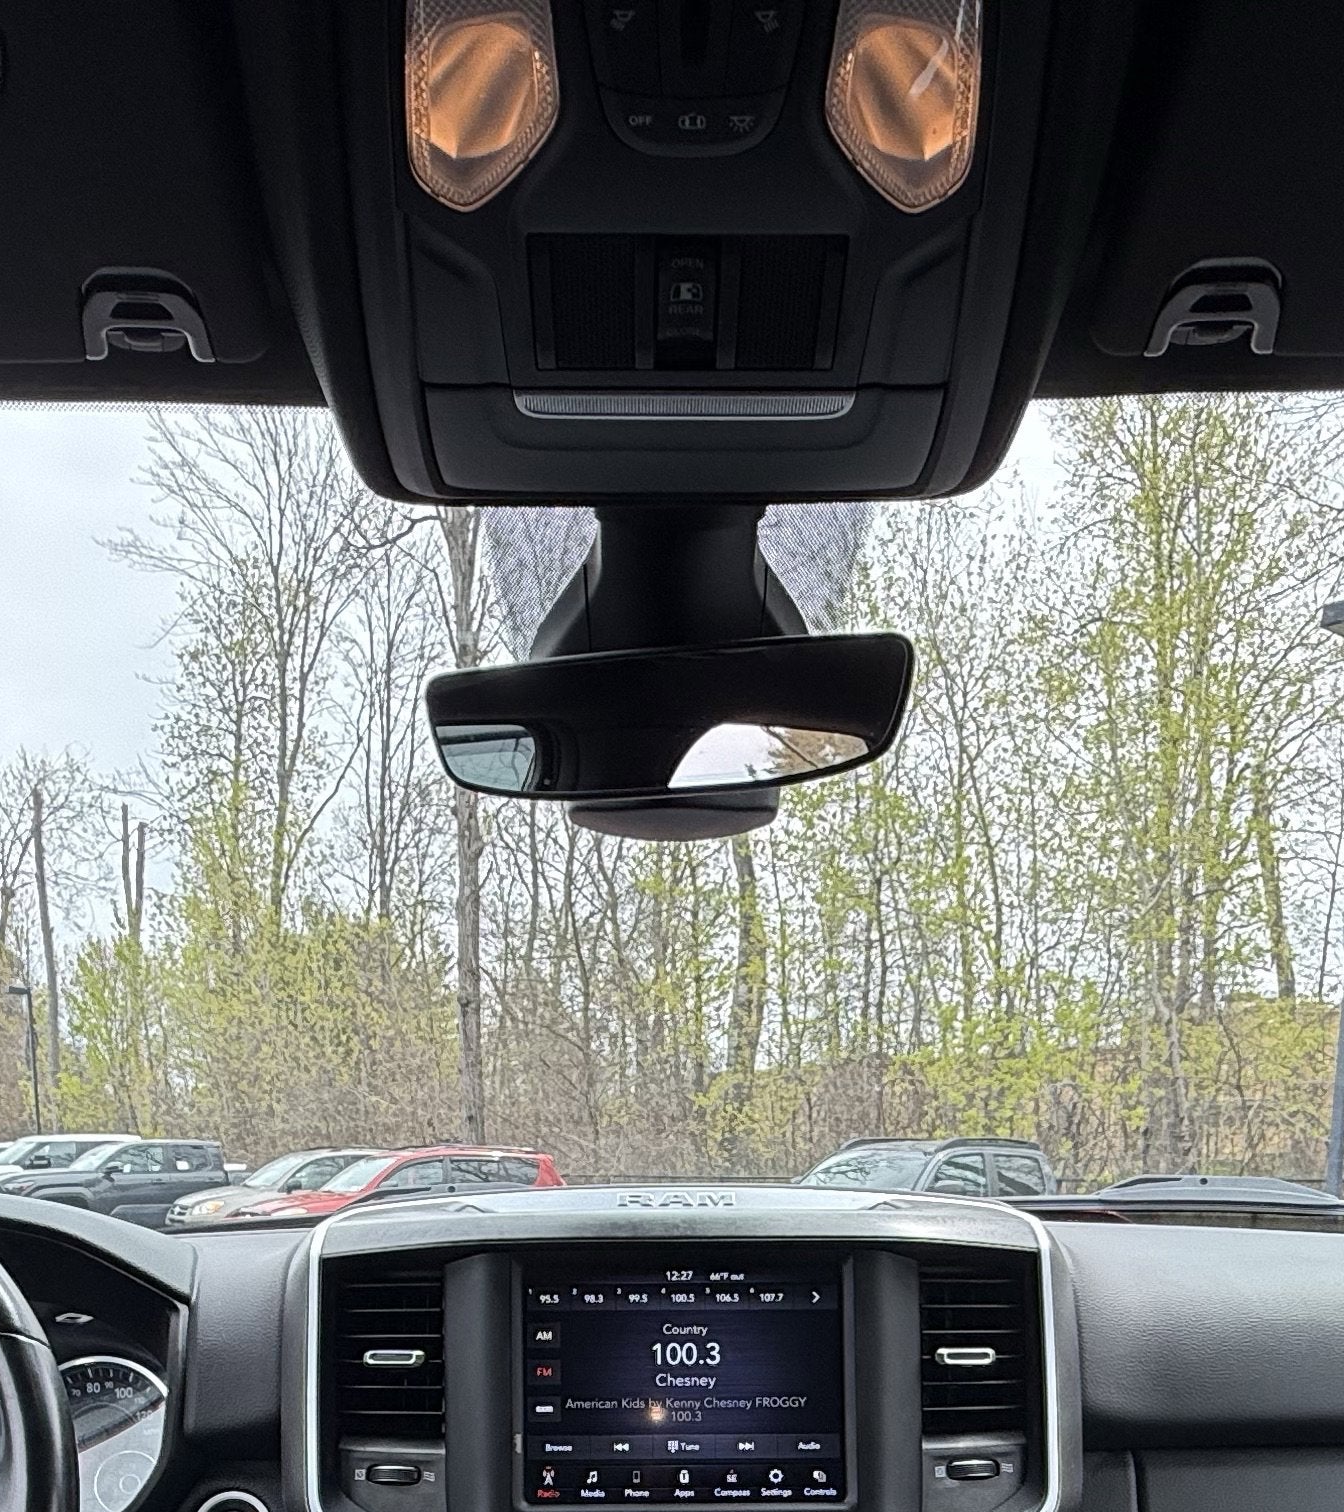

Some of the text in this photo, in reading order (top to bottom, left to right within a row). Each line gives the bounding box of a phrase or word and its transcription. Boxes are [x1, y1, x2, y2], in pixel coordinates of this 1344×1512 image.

[628, 116, 653, 127] OFF
[671, 258, 705, 269] OPEN
[617, 1192, 736, 1207] RAM
[665, 1270, 693, 1281] 12:27
[759, 1293, 784, 1302] 107.7
[535, 1331, 553, 1341] AM
[662, 1324, 708, 1337] Country
[652, 1342, 721, 1366] 100.3
[536, 1367, 552, 1376] FM
[656, 1373, 717, 1388] Chesney
[86, 1382, 101, 1394] 80
[114, 1387, 133, 1399] 100
[565, 1398, 618, 1409] American
[621, 1397, 646, 1409] Kids
[666, 1398, 701, 1411] Kenny
[704, 1397, 753, 1411] Chesney
[755, 1397, 806, 1408] FROGGY
[671, 1411, 702, 1422] 100.3
[545, 1443, 572, 1452] Browse
[680, 1442, 700, 1451] Tune
[797, 1441, 821, 1451] Audio
[581, 1488, 605, 1497] Media
[624, 1488, 650, 1497] Phone
[674, 1488, 695, 1499] Apps
[714, 1488, 750, 1498] Compass
[760, 1487, 792, 1499] Settings
[804, 1487, 837, 1497] Controls
